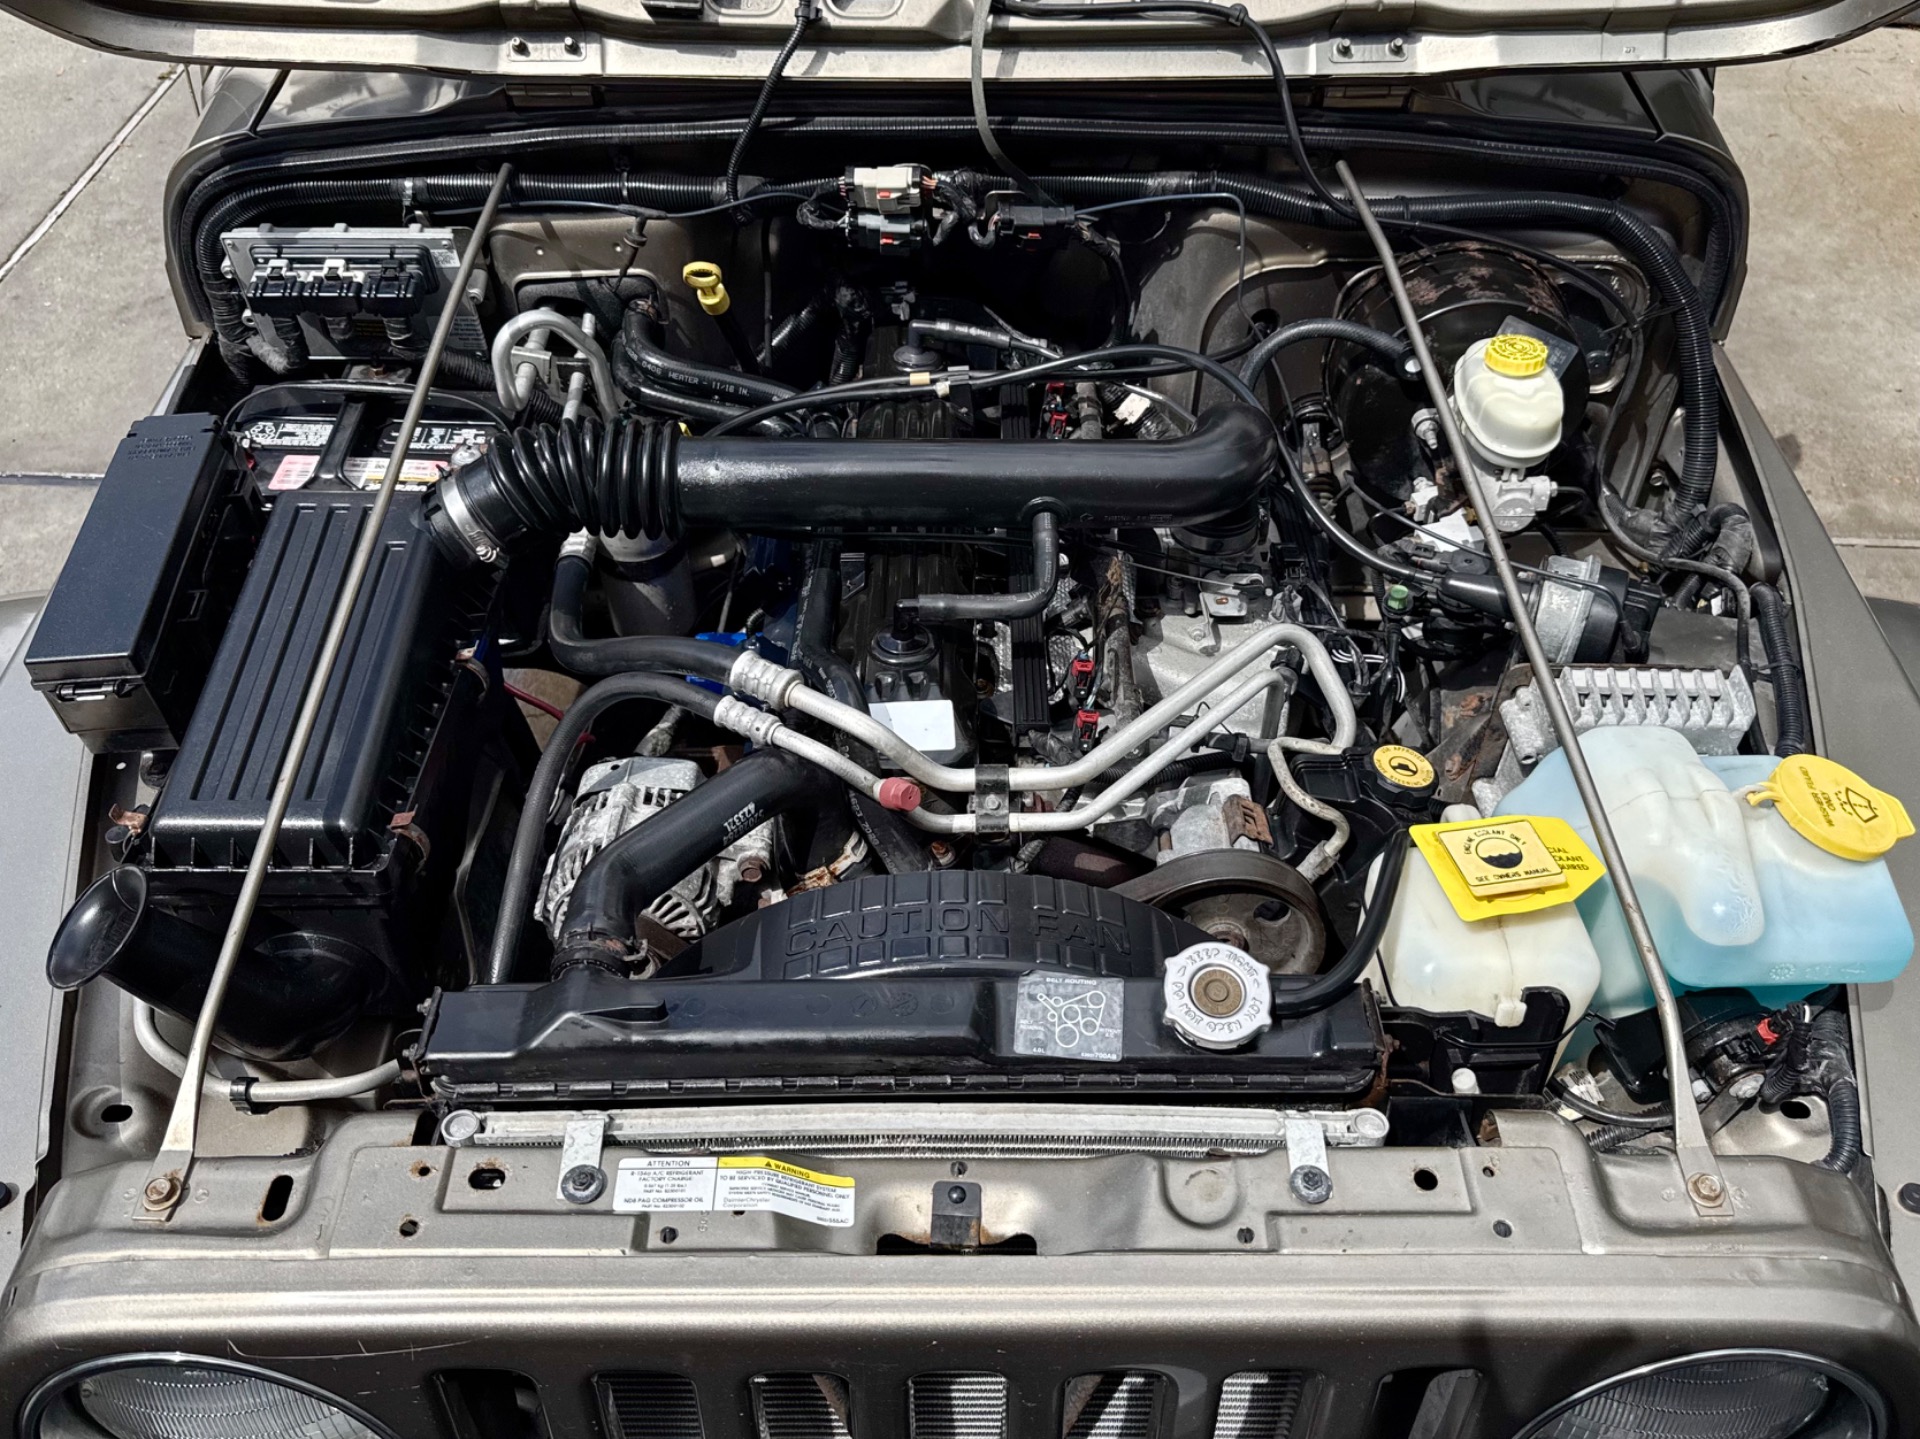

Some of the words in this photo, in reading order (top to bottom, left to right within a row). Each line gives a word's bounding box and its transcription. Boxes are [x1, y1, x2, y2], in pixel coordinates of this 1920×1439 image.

[668, 371, 698, 385] HEATER
[1393, 746, 1425, 763] APPROVED
[1390, 774, 1423, 786] STEERING
[1463, 835, 1476, 855] ENGINE
[1474, 829, 1505, 838] COOLANT
[1546, 846, 1569, 854] CIAL
[1552, 854, 1584, 863] OLANT
[1475, 875, 1490, 883] SEE
[1493, 871, 1522, 880] OWNERS
[1523, 867, 1552, 876] MANUAL
[786, 906, 1010, 957] CAUTION
[1035, 912, 1130, 957] FAN
[1185, 947, 1220, 966] KEEP
[1225, 949, 1259, 978] TIGHT
[1064, 978, 1097, 986] ROUTING
[1172, 981, 1185, 1000] DO
[1178, 1002, 1204, 1025] NOT
[1243, 996, 1263, 1022] HOT
[1206, 1019, 1243, 1034] OPEN
[774, 1162, 811, 1179] WARNING
[775, 1178, 802, 1189] QUALIFIED
[803, 1186, 833, 1198] PERSONNEL
[781, 1174, 815, 1188] REFRIGERANT
[816, 1185, 837, 1193] SYSTEM
